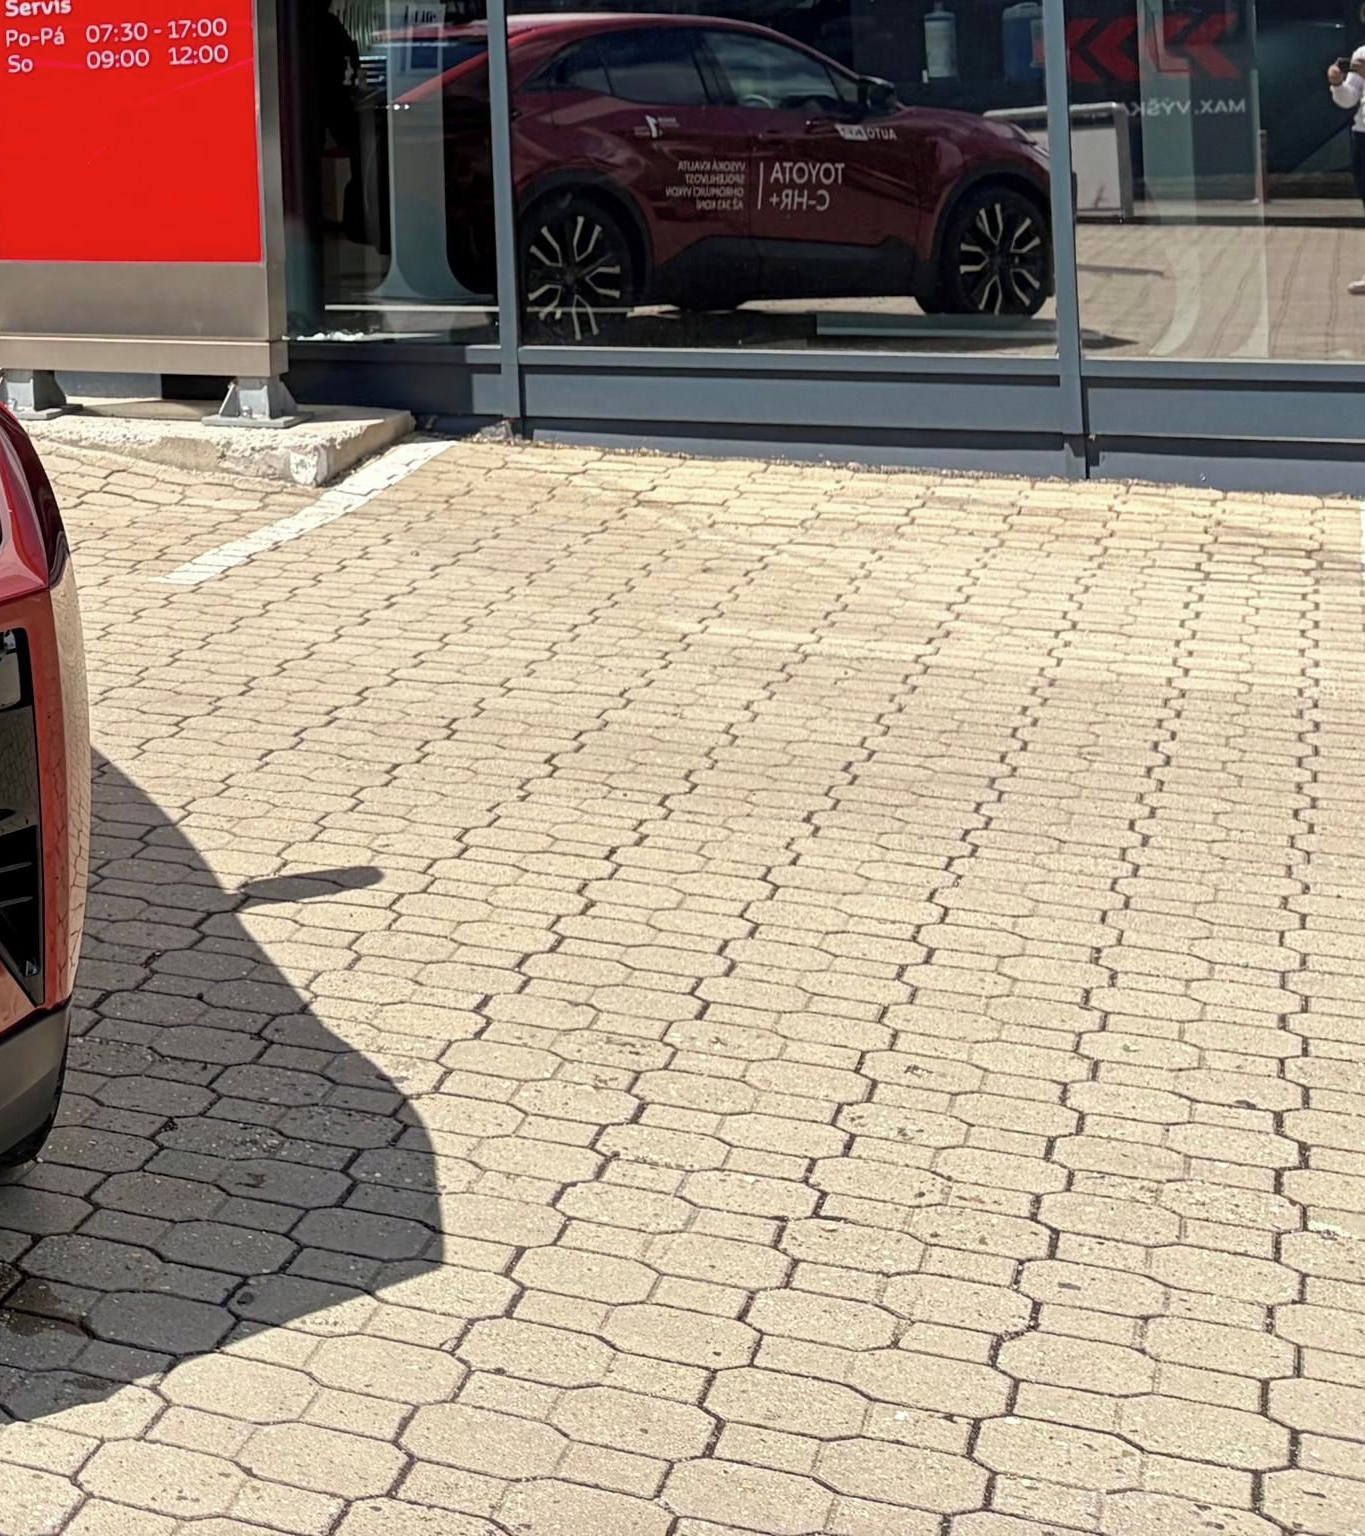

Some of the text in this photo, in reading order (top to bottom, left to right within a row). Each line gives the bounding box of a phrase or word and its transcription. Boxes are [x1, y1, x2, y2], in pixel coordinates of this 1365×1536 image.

[5, 26, 66, 48] Po-Pá
[85, 22, 149, 45] 07:30
[167, 18, 228, 40] 17:00
[8, 44, 229, 74] So 09:00 12:00
